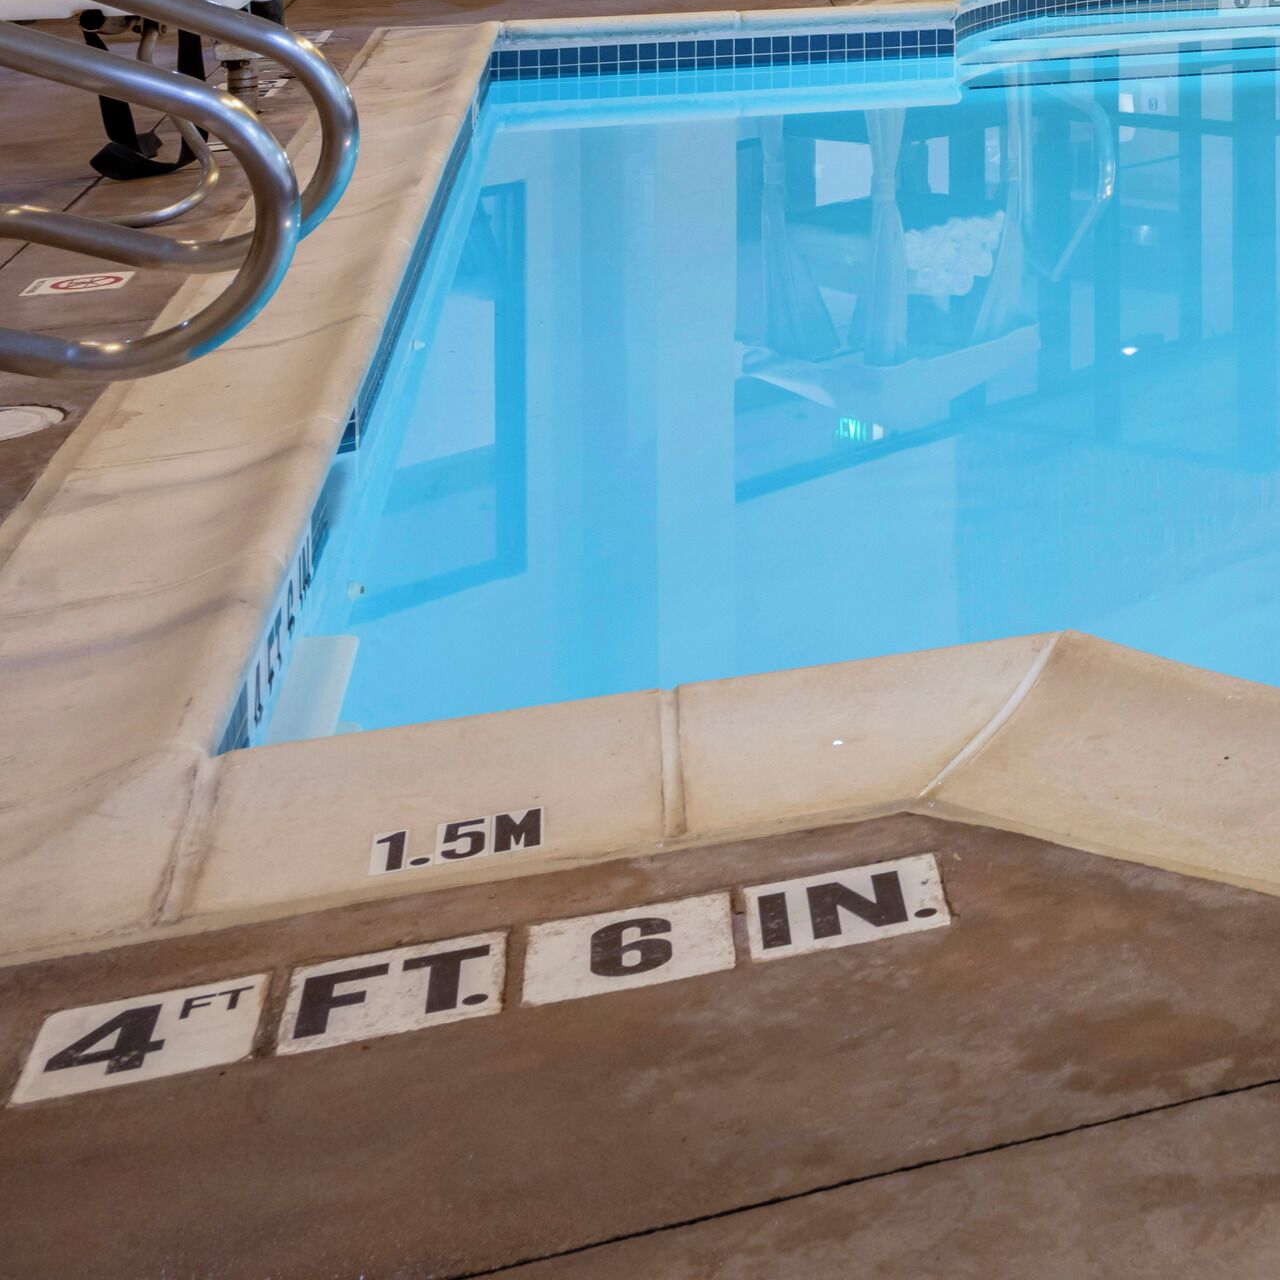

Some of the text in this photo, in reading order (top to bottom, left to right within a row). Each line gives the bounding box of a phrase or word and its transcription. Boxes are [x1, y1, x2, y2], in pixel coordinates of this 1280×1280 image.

[376, 808, 542, 872] 1.5M
[292, 944, 492, 1040] FT.
[590, 916, 673, 978] 6
[757, 869, 939, 951] IN.
